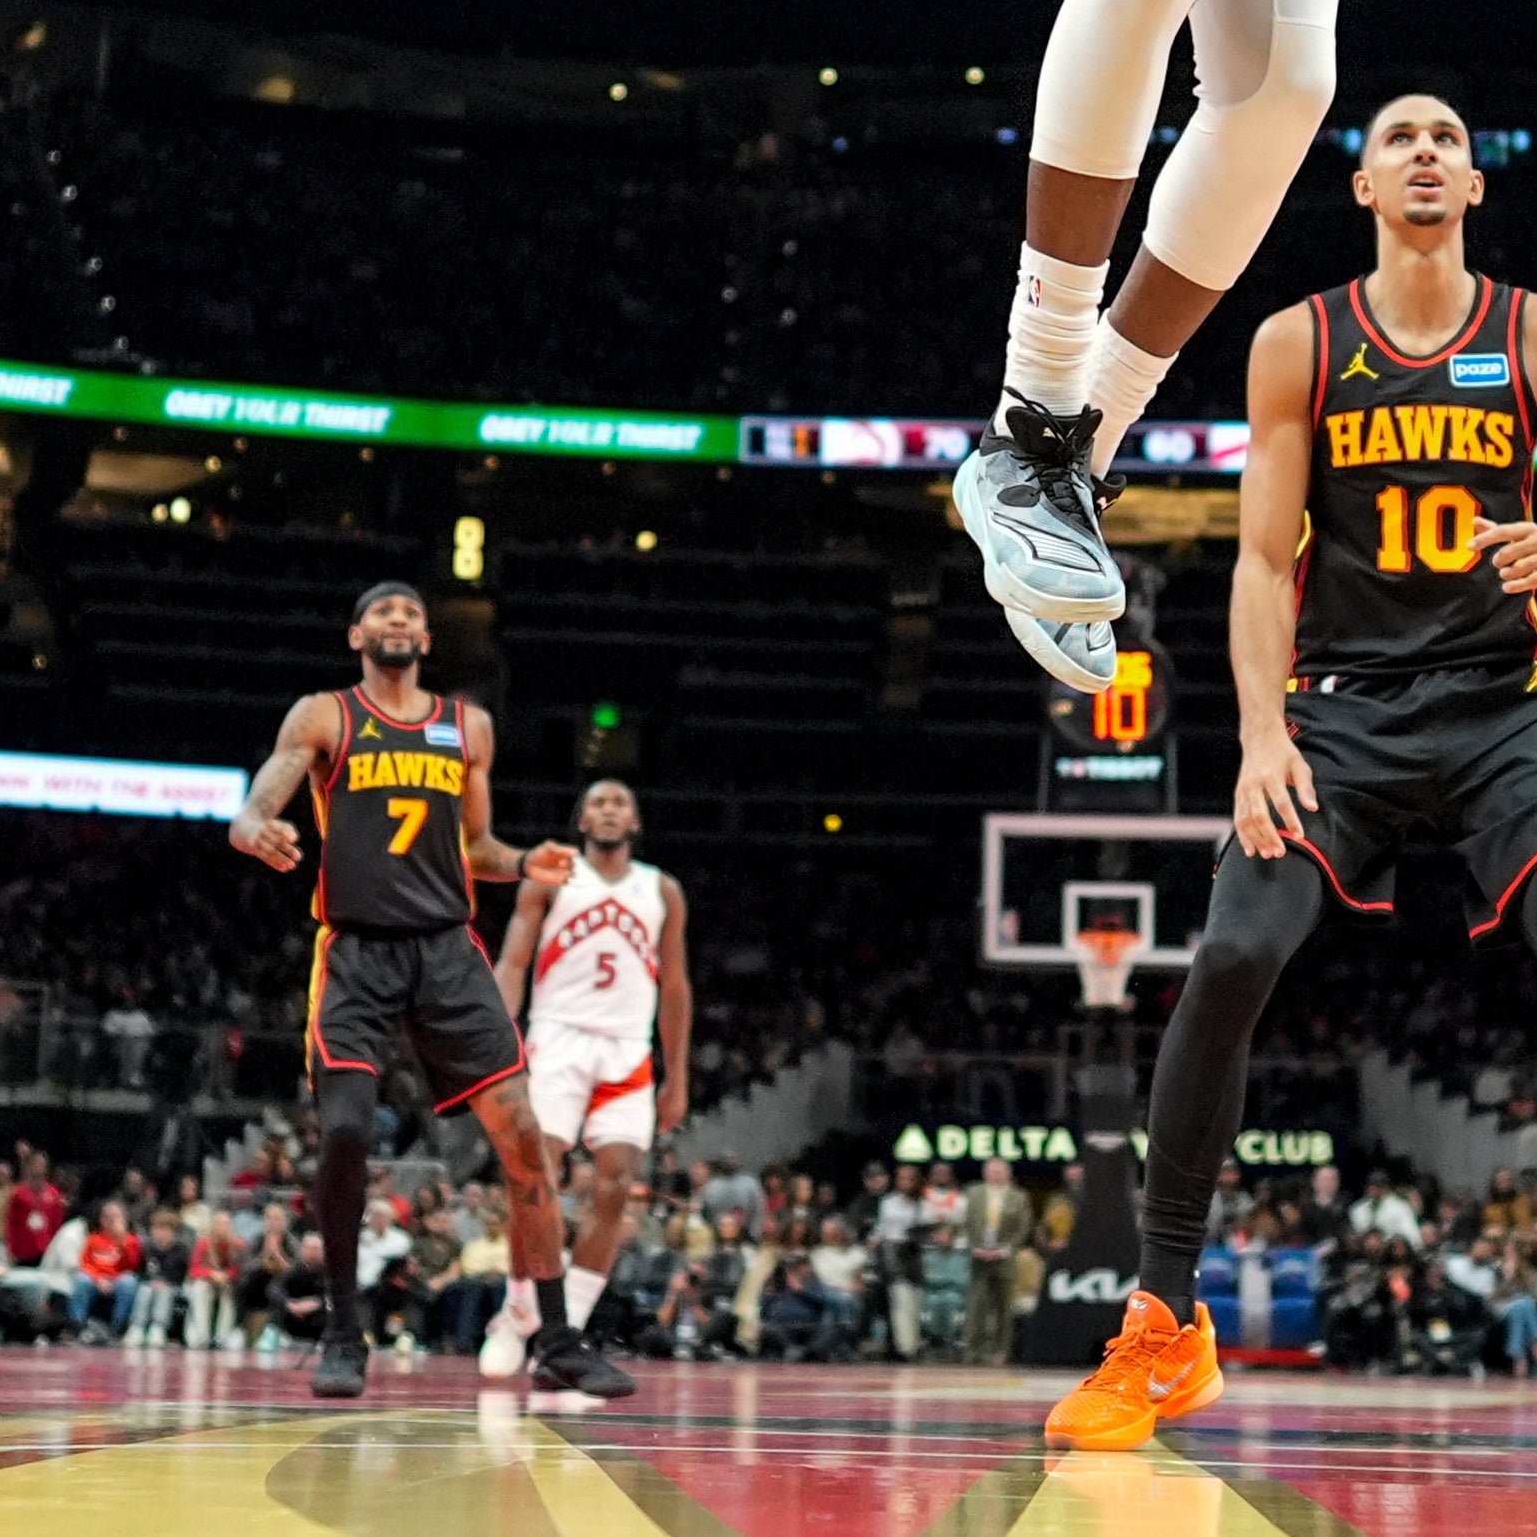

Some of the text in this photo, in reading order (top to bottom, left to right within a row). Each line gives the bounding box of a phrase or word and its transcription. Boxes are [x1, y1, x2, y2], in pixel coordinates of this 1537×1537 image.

[1326, 405, 1515, 469] HAWKS
[1375, 484, 1483, 574] 10
[1094, 685, 1148, 741] 10
[348, 751, 464, 797] HAWKS
[387, 797, 430, 855] 7
[594, 952, 616, 989] 5
[937, 1124, 1078, 1162] DELTA
[1234, 1129, 1334, 1165] CLUB
